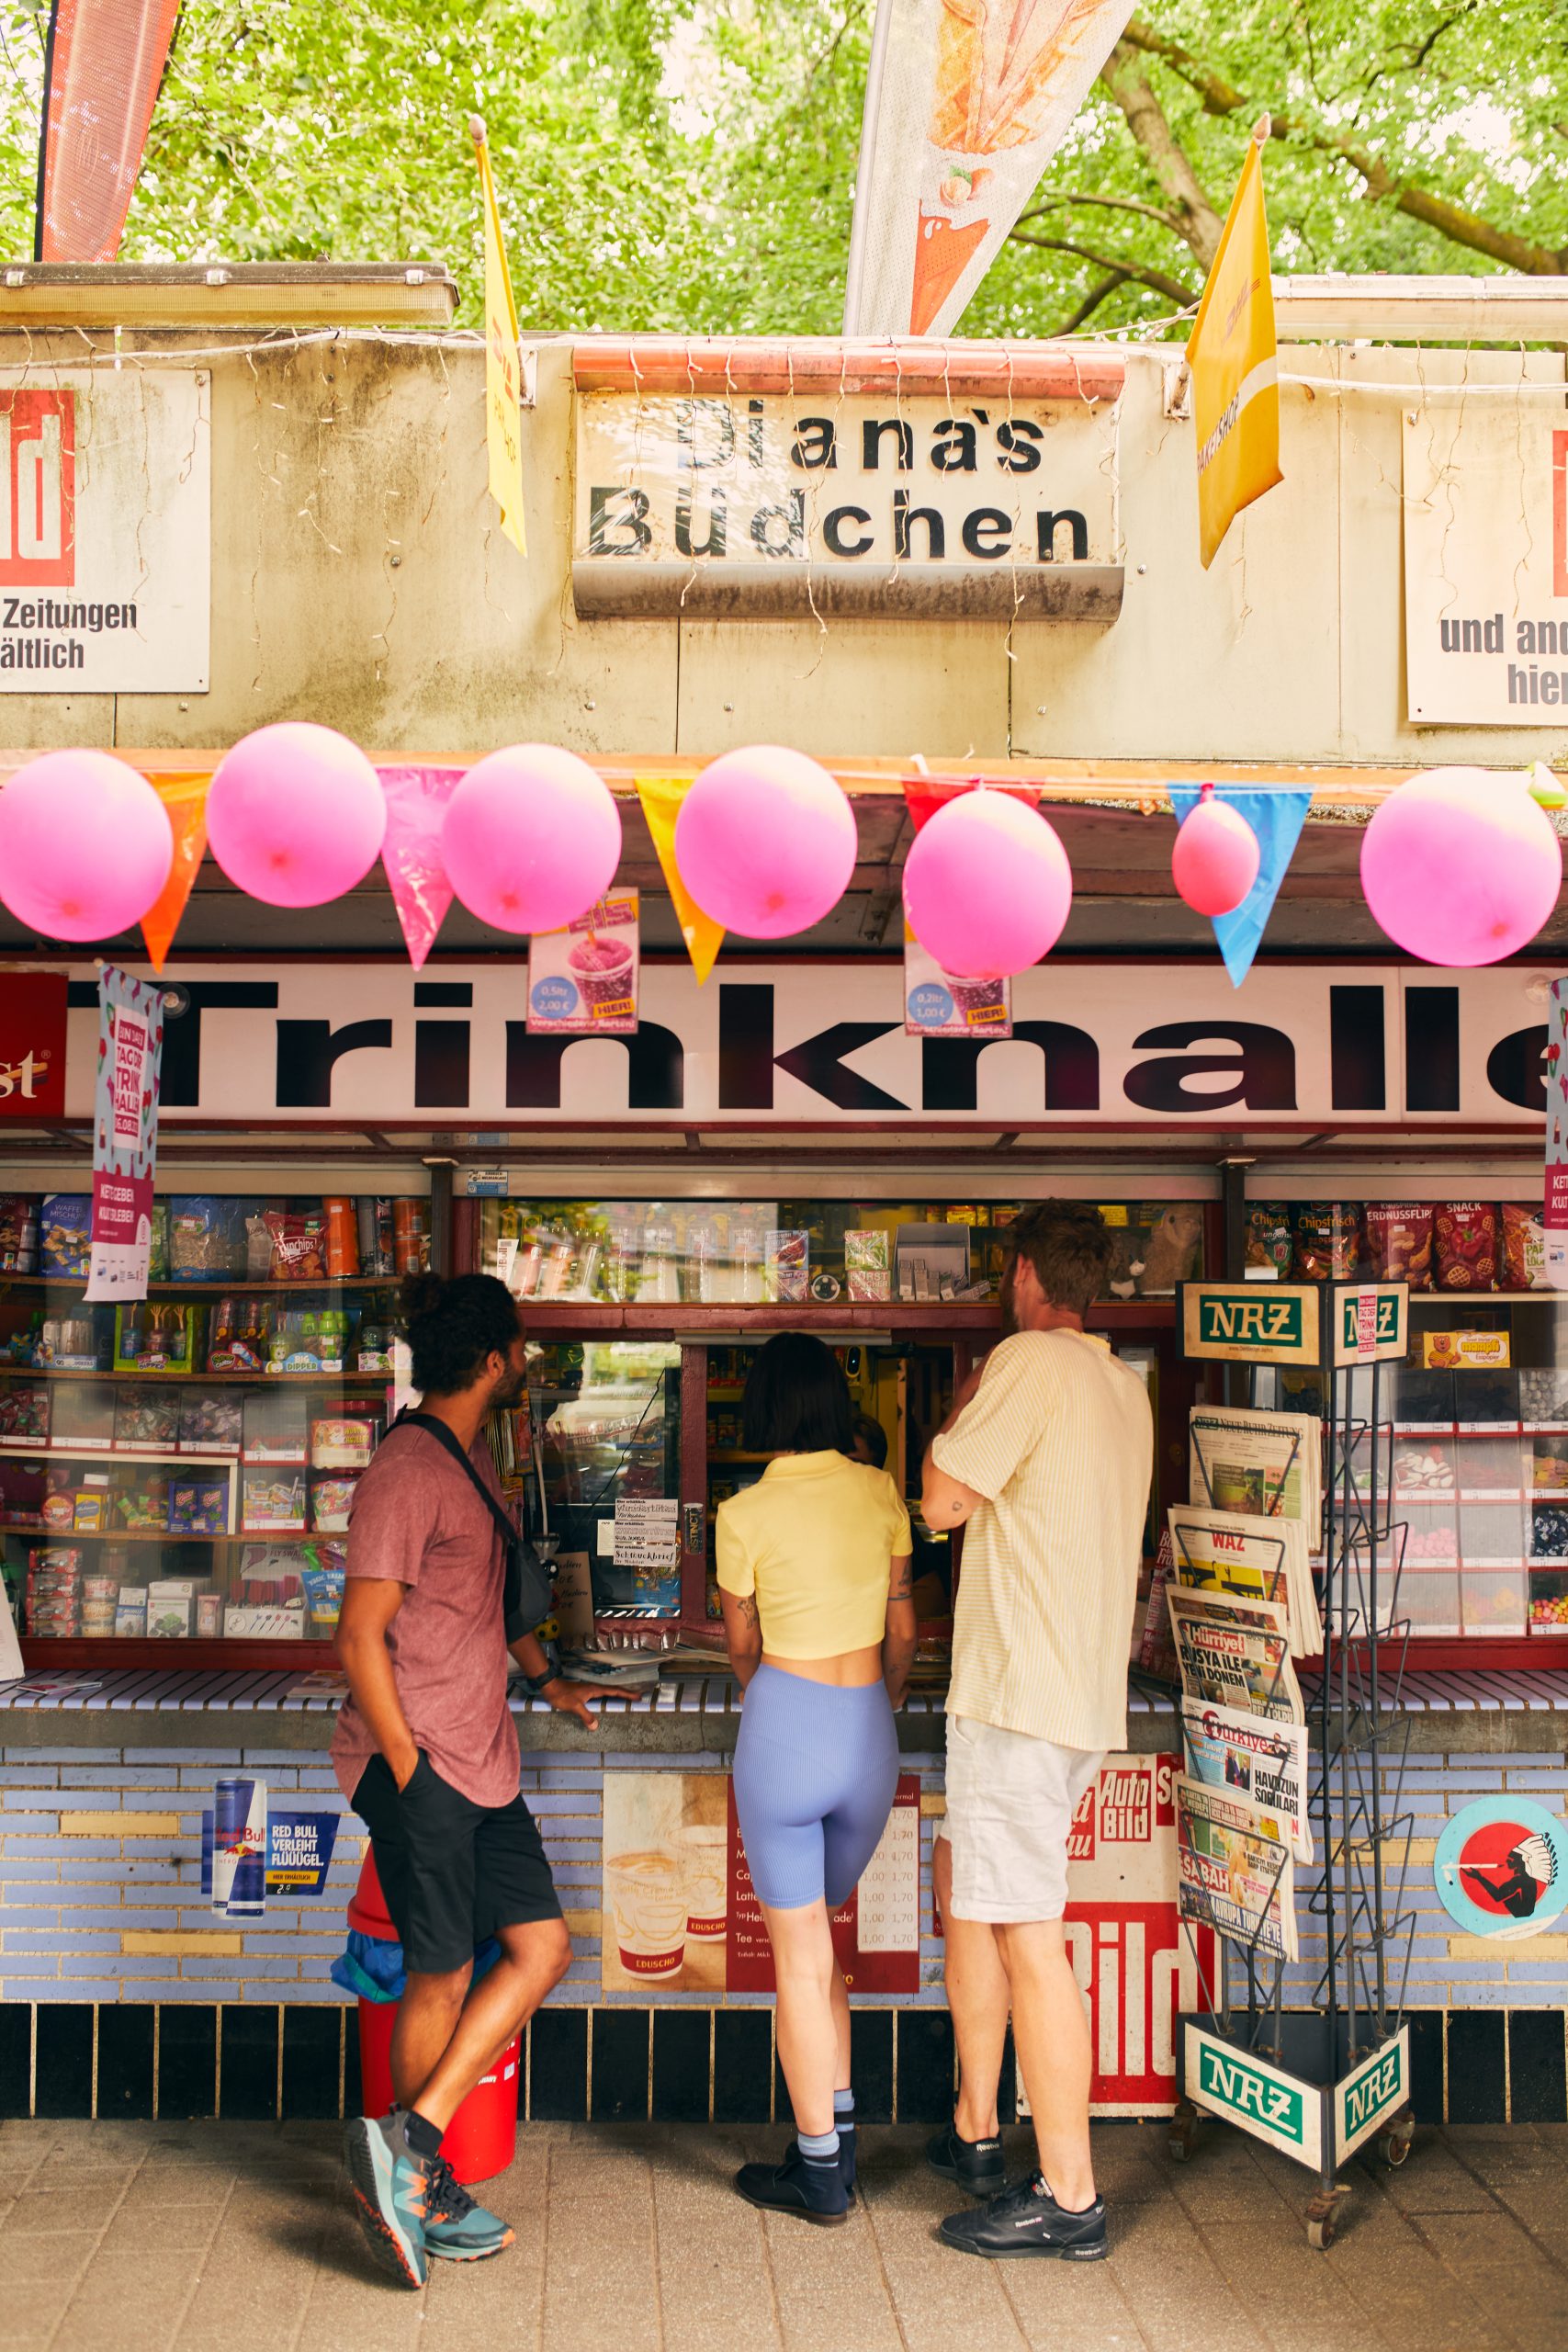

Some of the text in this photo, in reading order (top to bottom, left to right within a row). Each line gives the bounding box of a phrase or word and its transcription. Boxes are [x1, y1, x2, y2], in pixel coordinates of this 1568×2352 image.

[588, 485, 1089, 560] Büdchen
[3, 598, 137, 633] Zeitungen
[1440, 613, 1504, 654] und
[598, 1001, 631, 1015] HIER!
[971, 1007, 1003, 1022] HIER!
[1447, 1202, 1483, 1214] SNACK
[1298, 1214, 1356, 1229] Chipsfrisch
[1203, 1301, 1297, 1341] NRZ
[1345, 1301, 1395, 1342] NZ
[1461, 1340, 1501, 1355] mampfi
[287, 1362, 318, 1372] DIPPER
[294, 1354, 309, 1363] BIG
[1212, 1530, 1246, 1552] WAZ
[1192, 1625, 1245, 1653] Hürriyet
[1207, 1714, 1268, 1753] Türkiye
[1101, 1770, 1147, 1807] Auto
[272, 1825, 318, 1838] RED BULL
[1103, 1807, 1147, 1840] Bild
[216, 1826, 265, 1843] Red Bull
[272, 1838, 317, 1851] VERLEIHT
[271, 1852, 324, 1867] FLÜÜÜGEL.
[1182, 1854, 1231, 1894] SABAH
[691, 1921, 726, 1931] EDUSCHO
[736, 1933, 752, 1943] Tee
[636, 1957, 675, 1969] EDUSCHO
[1203, 2051, 1298, 2136] NRZ
[1347, 2053, 1399, 2132] NRZ
